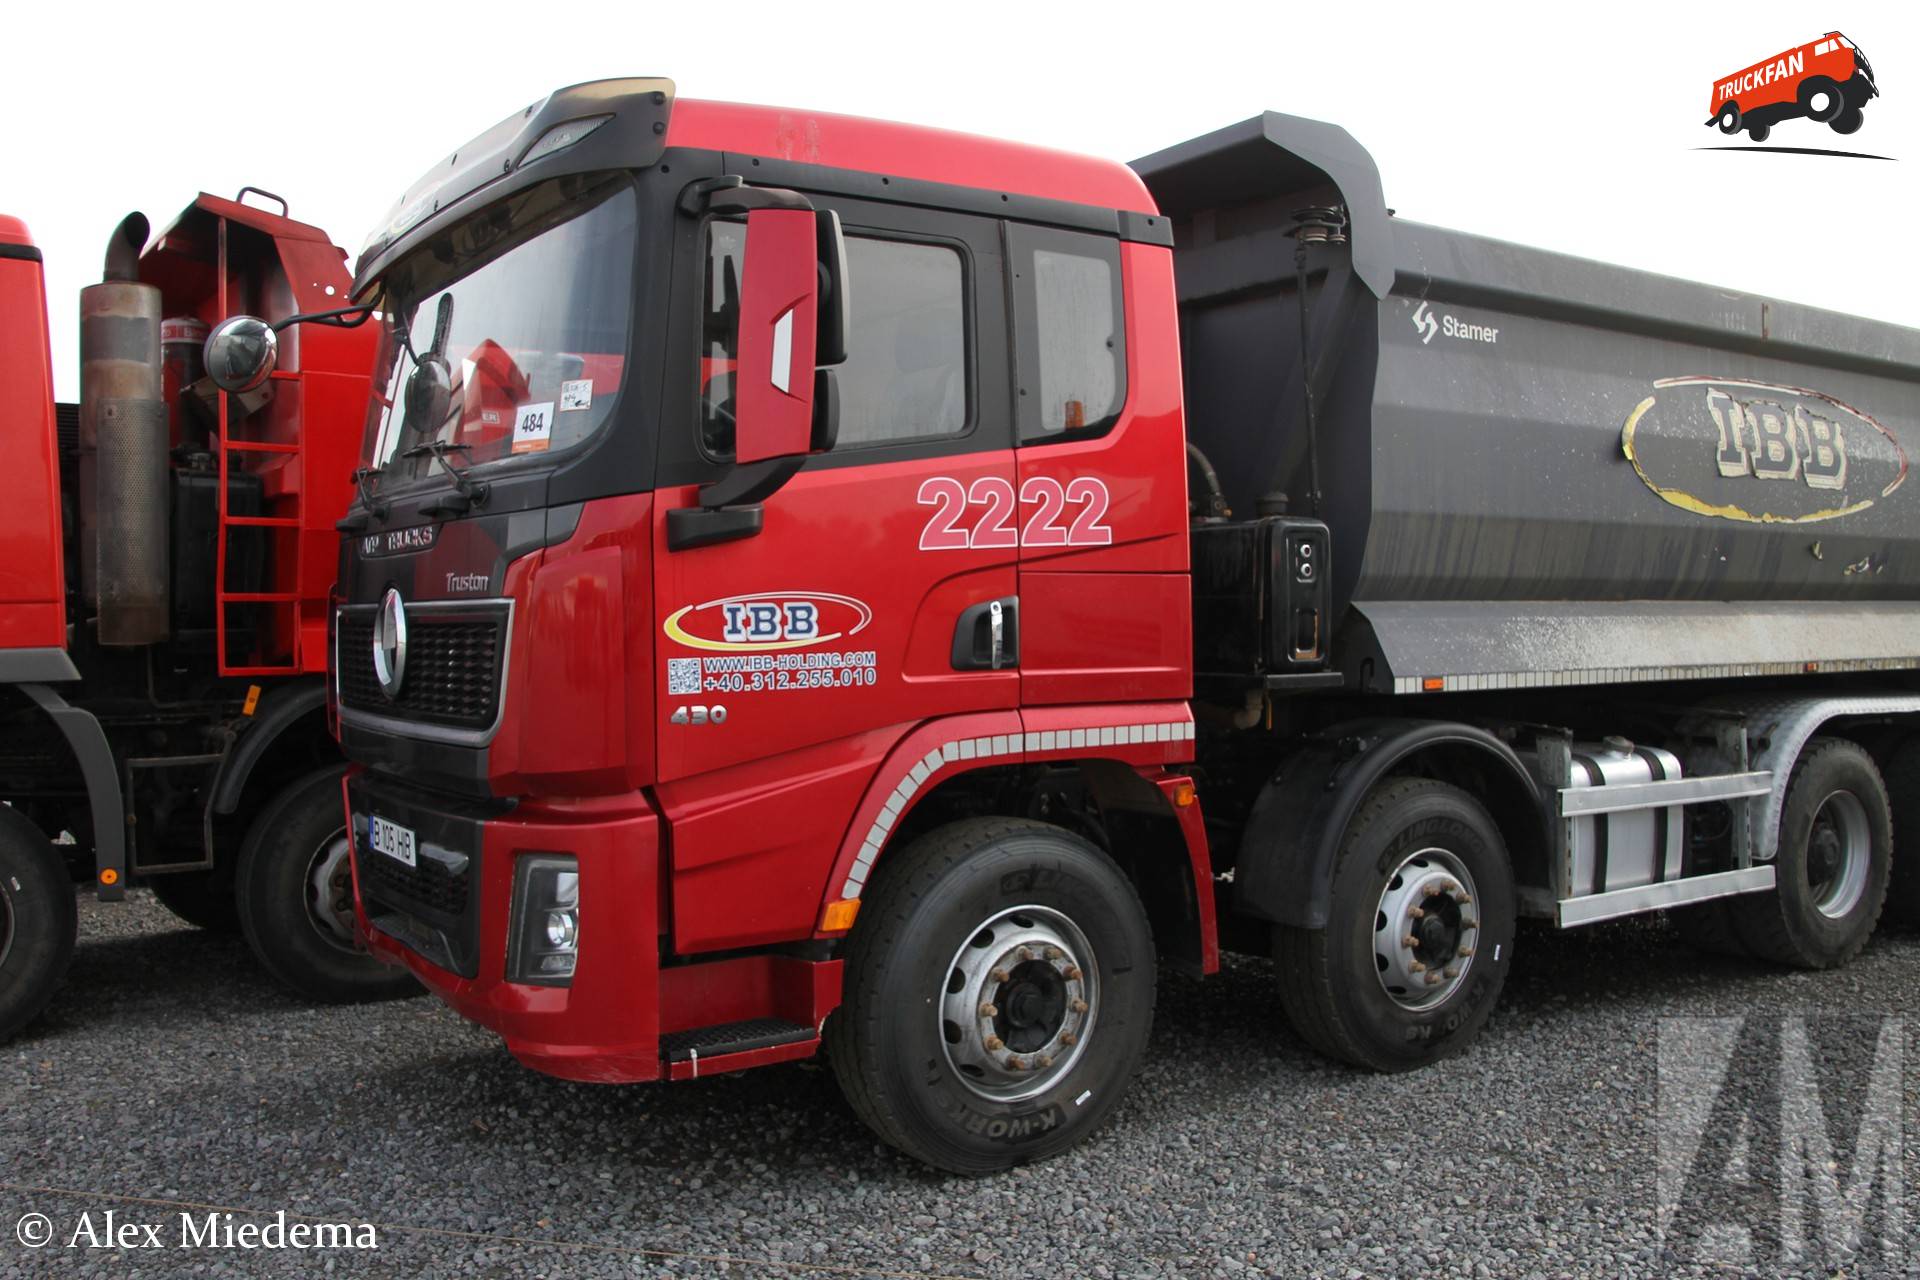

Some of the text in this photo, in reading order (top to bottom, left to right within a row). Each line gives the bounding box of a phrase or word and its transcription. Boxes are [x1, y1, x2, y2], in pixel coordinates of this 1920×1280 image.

[1442, 315, 1499, 343] Stamer
[522, 412, 544, 434] 484
[1706, 387, 1847, 490] IBB
[917, 476, 1112, 550] 2222
[446, 572, 489, 592] Truston
[723, 602, 818, 641] IBB
[704, 651, 876, 673] WWW.IBB-HOLDING.COM
[704, 668, 876, 691] +40.312.255.010
[670, 705, 728, 725] 430
[374, 820, 380, 846] B
